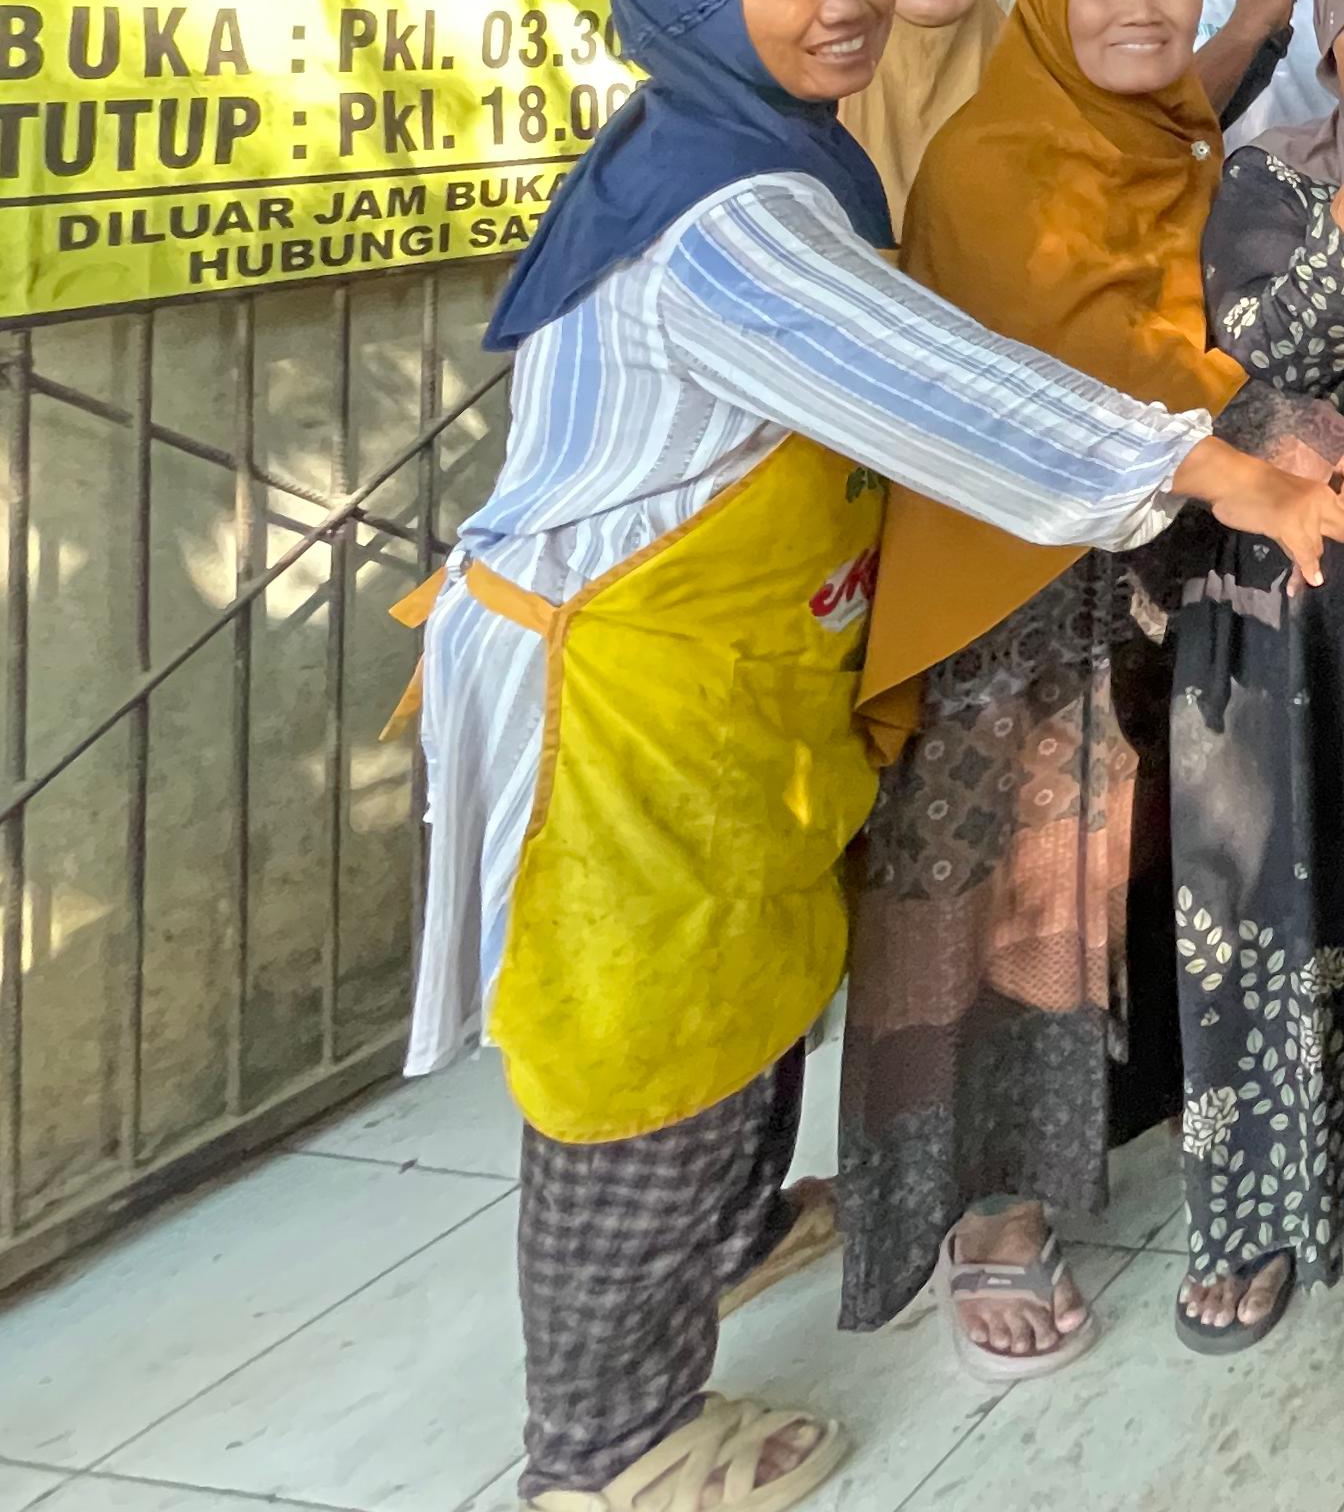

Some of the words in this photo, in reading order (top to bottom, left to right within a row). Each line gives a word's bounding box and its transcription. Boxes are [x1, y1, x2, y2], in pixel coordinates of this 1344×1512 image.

[0, 5, 250, 80] BUKA
[338, 8, 456, 75] Pkl.
[0, 96, 261, 179] TUTUP
[338, 90, 456, 157] Pkl.
[60, 197, 295, 252] DILUAR
[314, 185, 427, 226] JAM
[188, 227, 450, 284] HUBUNGI
